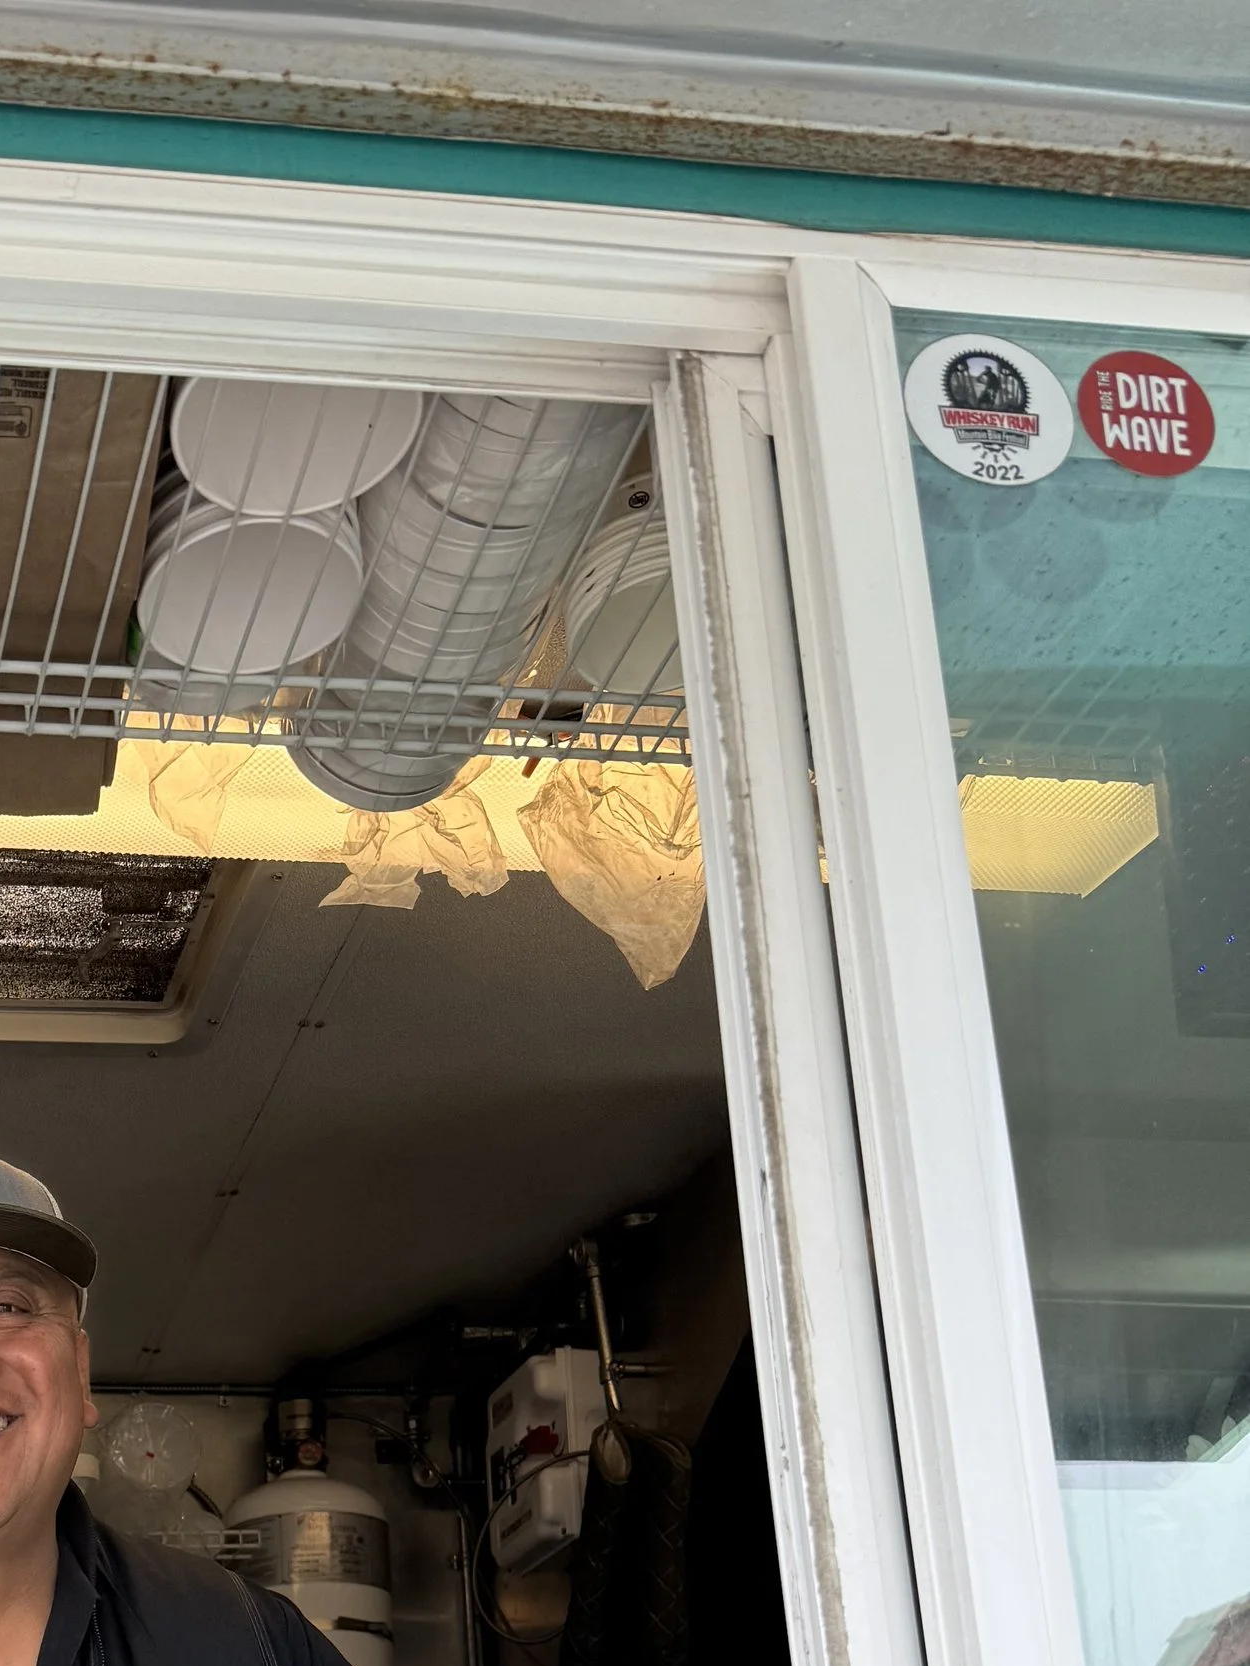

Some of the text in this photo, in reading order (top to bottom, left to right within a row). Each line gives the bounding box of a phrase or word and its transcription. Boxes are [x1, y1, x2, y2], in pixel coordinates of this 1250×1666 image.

[1096, 370, 1110, 387] THE
[1099, 390, 1114, 411] RIDE
[1115, 371, 1188, 416] DIRT
[943, 409, 1036, 433] WHISKEY RUN
[1101, 412, 1192, 457] WAVE
[972, 461, 1025, 481] 2022
